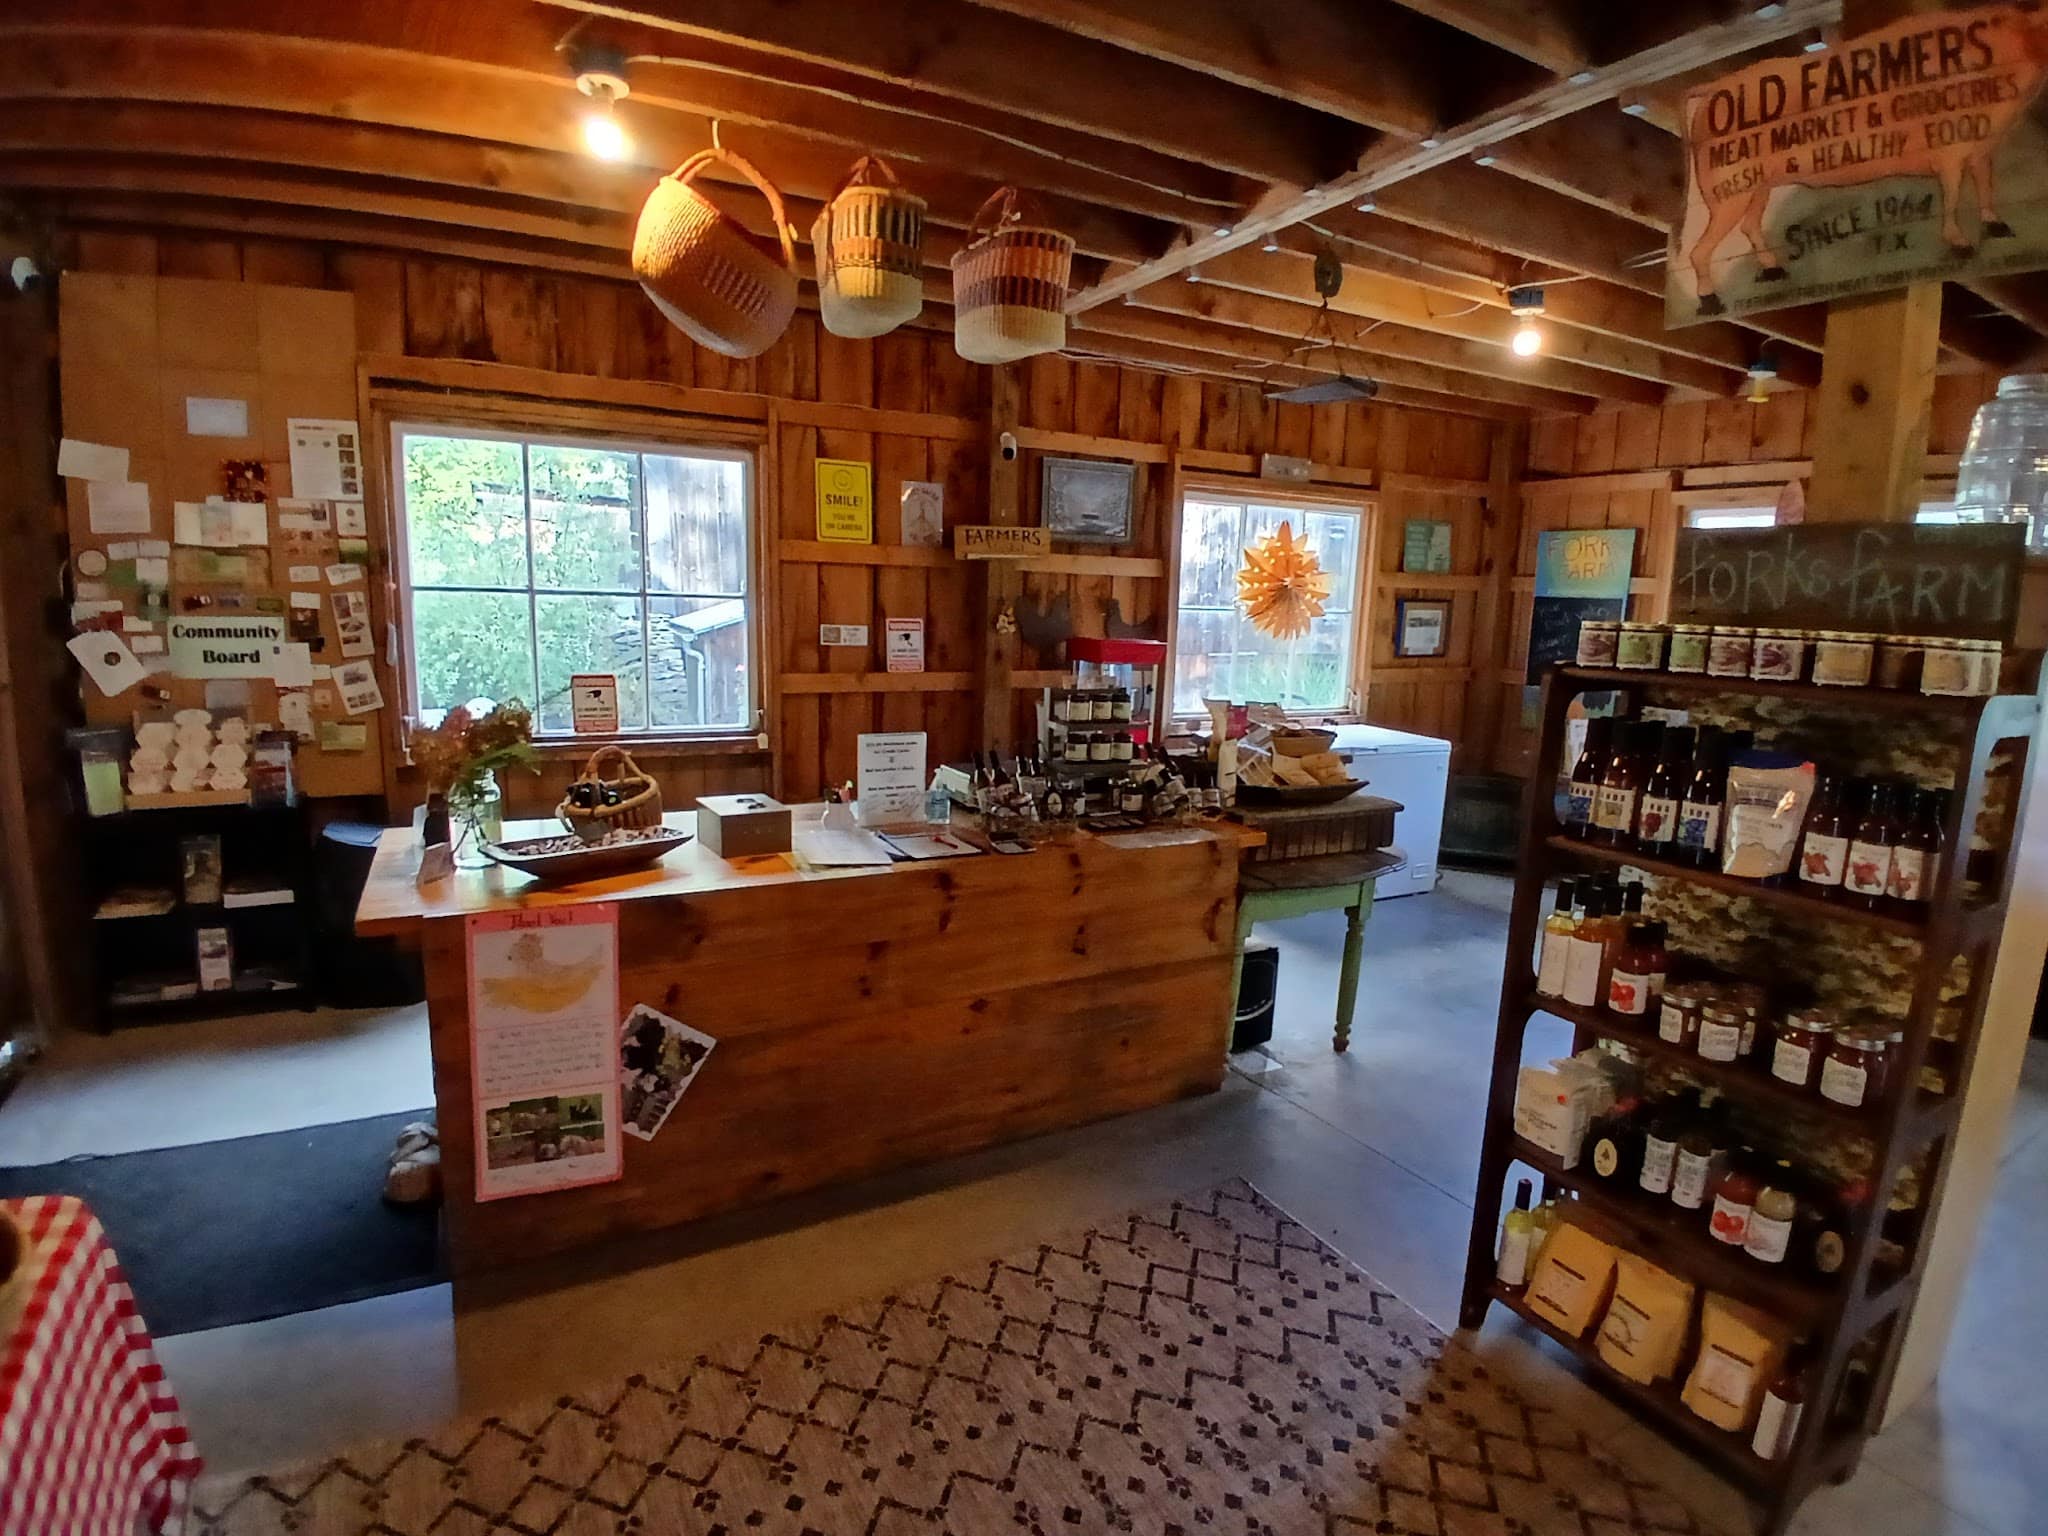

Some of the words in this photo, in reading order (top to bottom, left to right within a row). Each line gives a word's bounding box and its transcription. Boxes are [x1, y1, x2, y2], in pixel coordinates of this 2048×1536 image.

[1708, 74, 1786, 137] OLD
[1709, 132, 1762, 169] MEAT
[1770, 106, 1857, 153] MARKET
[1867, 102, 1883, 128] &
[1891, 73, 2019, 122] GROCERIES
[1712, 163, 1764, 203] FRESH
[1785, 156, 1799, 173] &
[1812, 132, 1909, 173] HEALTHY
[1924, 113, 1991, 149] FOOD
[1785, 206, 1864, 260] SINCE
[965, 528, 1041, 546] FARMERS
[172, 624, 280, 641] Community
[202, 649, 261, 664] Board
